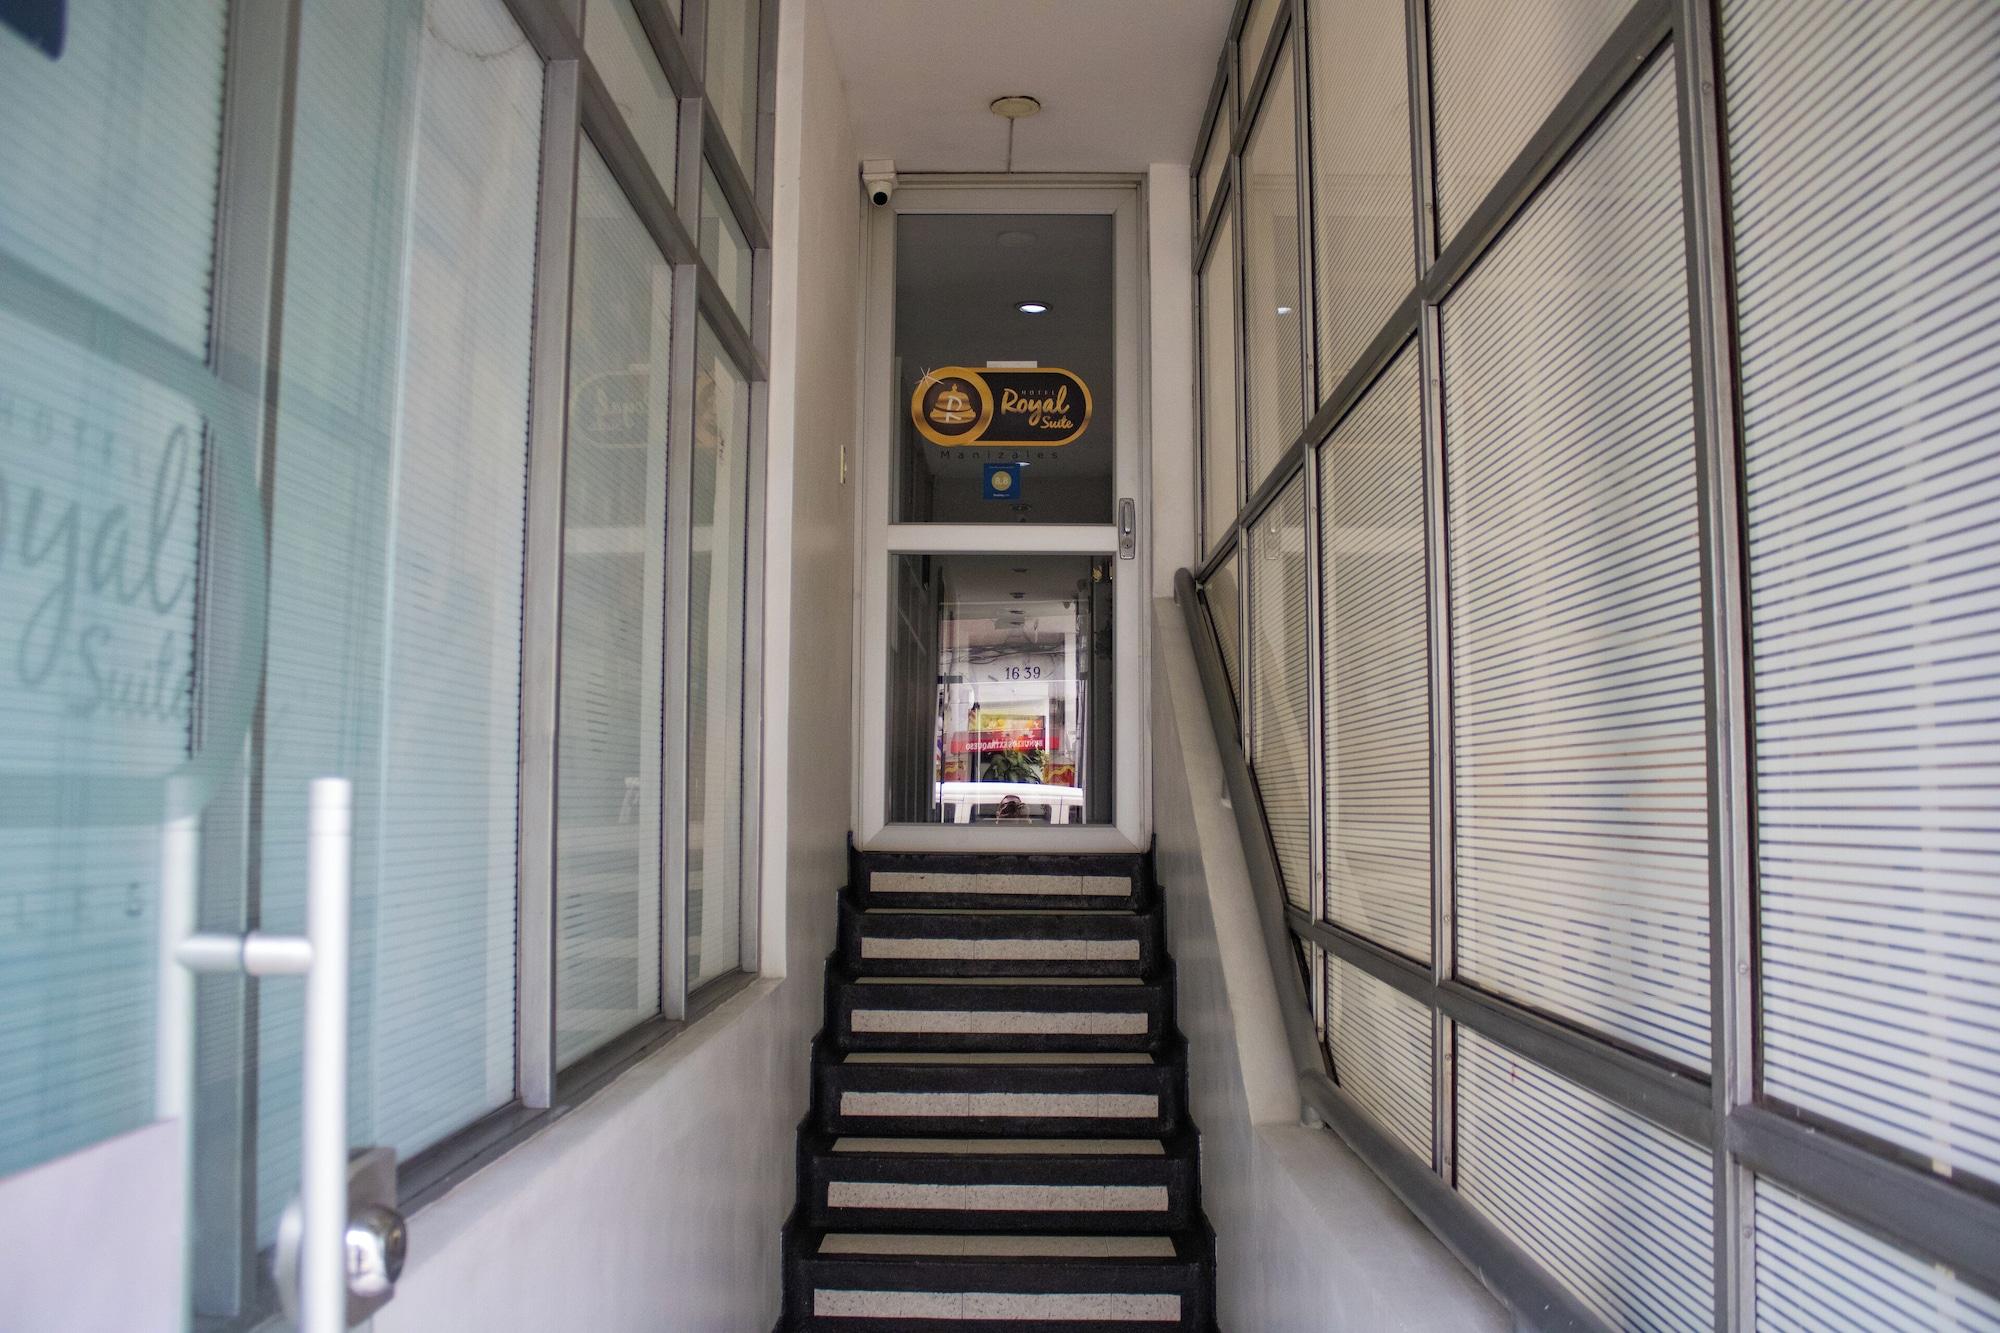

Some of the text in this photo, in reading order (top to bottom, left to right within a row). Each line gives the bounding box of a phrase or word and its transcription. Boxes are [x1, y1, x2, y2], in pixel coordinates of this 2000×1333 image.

[1001, 385, 1070, 426] Royal
[1040, 415, 1074, 429] Suite
[941, 450, 1058, 459] Manizales
[0, 424, 190, 688] yal
